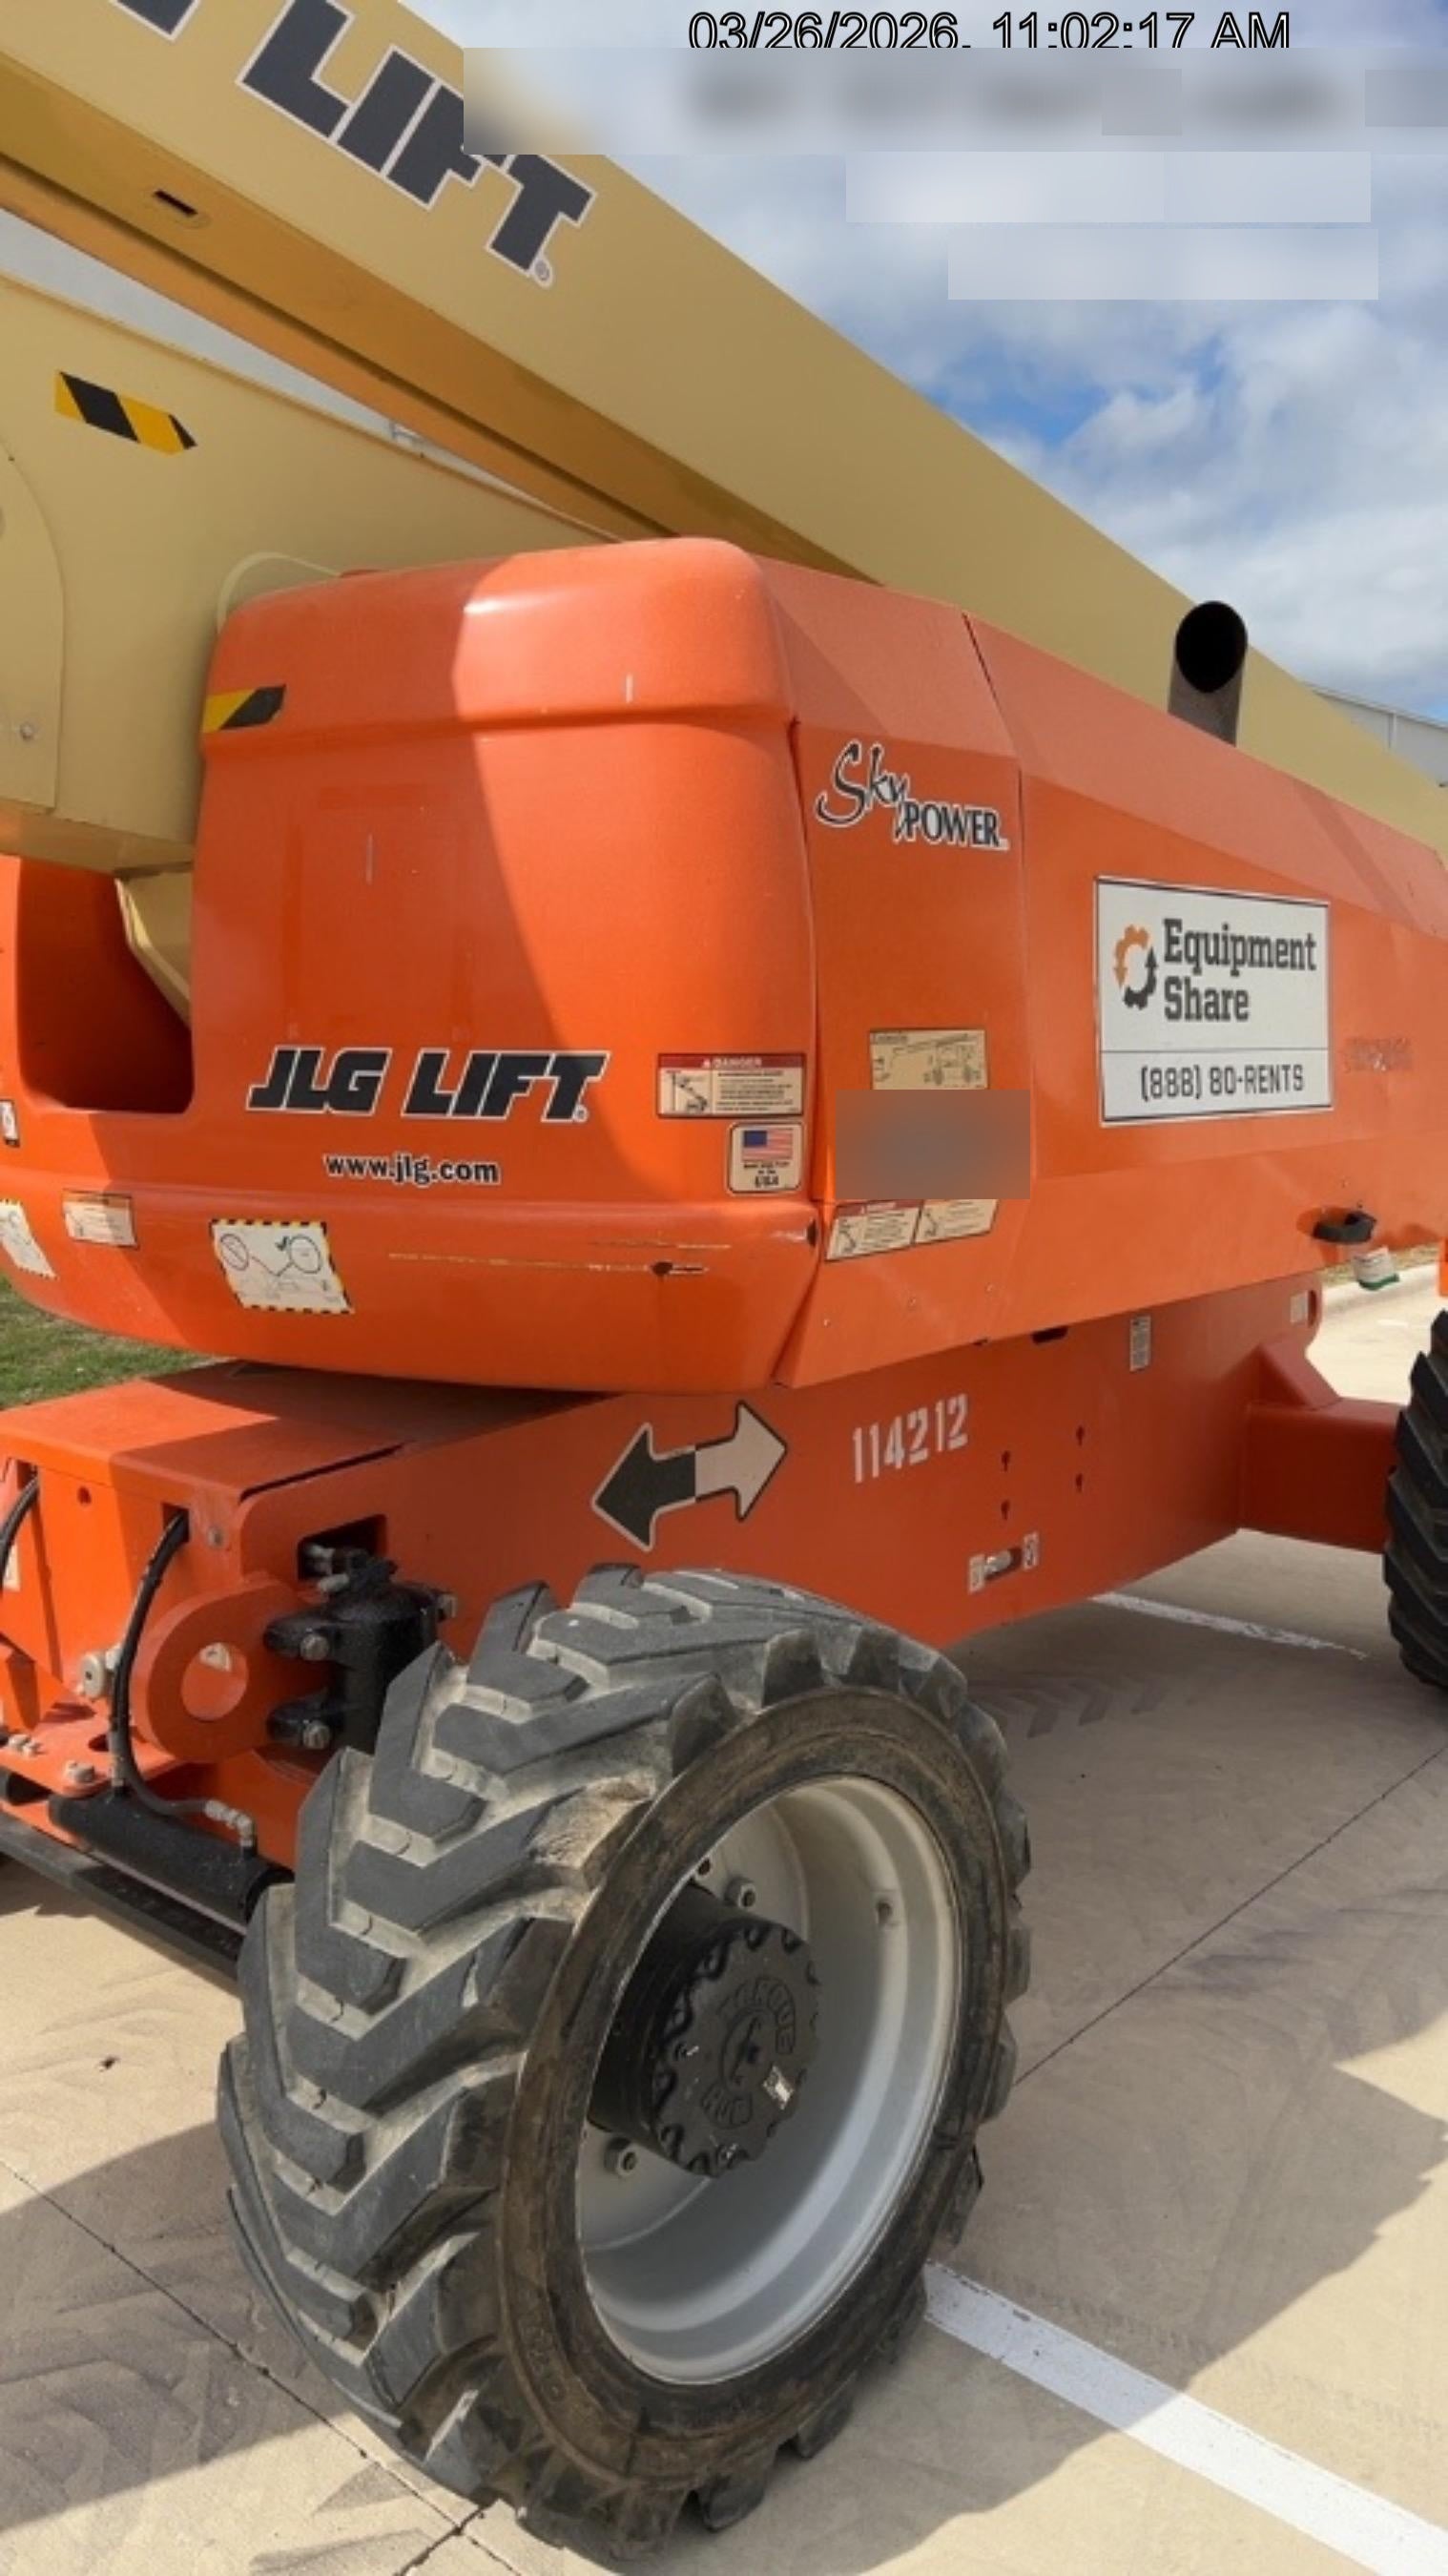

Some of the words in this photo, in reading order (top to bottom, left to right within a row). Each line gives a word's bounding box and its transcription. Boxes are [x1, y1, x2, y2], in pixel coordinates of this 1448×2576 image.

[1163, 918, 1317, 977] Equipment
[1163, 975, 1250, 1022] Share
[246, 1046, 393, 1116] JLG
[1140, 1064, 1203, 1102] (888)
[1209, 1063, 1305, 1097] 80-RENTS
[324, 1153, 500, 1186] www.jlg.com
[852, 1393, 969, 1484] 114212
